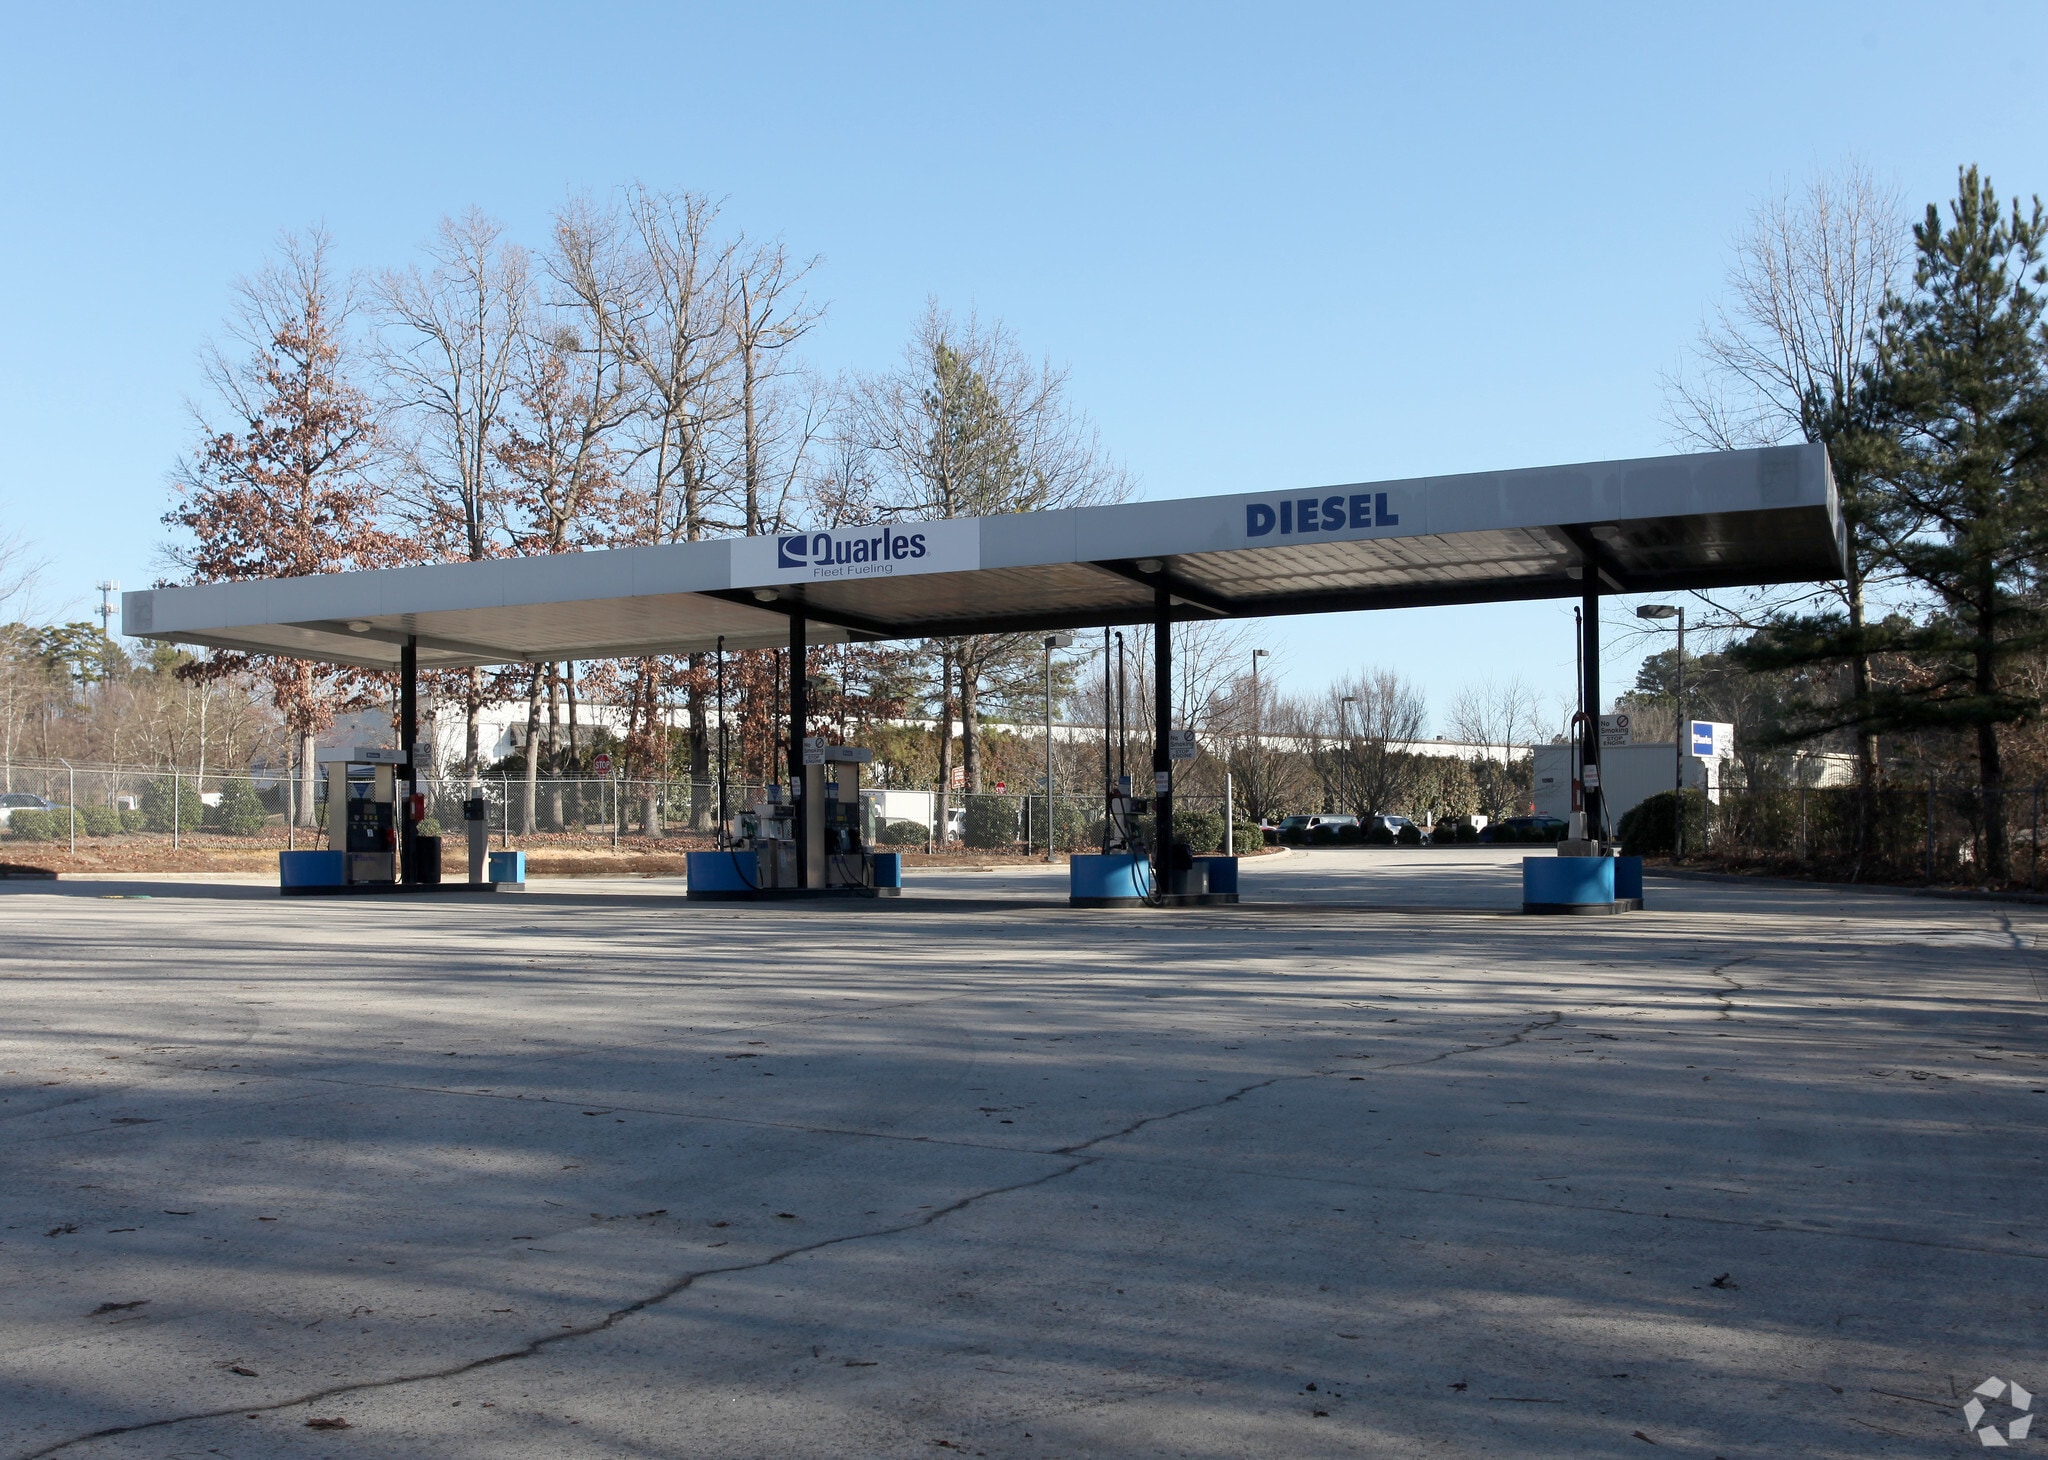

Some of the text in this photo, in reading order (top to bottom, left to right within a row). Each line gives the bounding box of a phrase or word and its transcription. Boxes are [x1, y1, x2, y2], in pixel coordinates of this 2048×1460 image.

[1246, 492, 1399, 537] DIESEL
[812, 527, 927, 566] Quarles
[813, 563, 893, 577] Fleet Fueling
[595, 760, 610, 769] STOP
